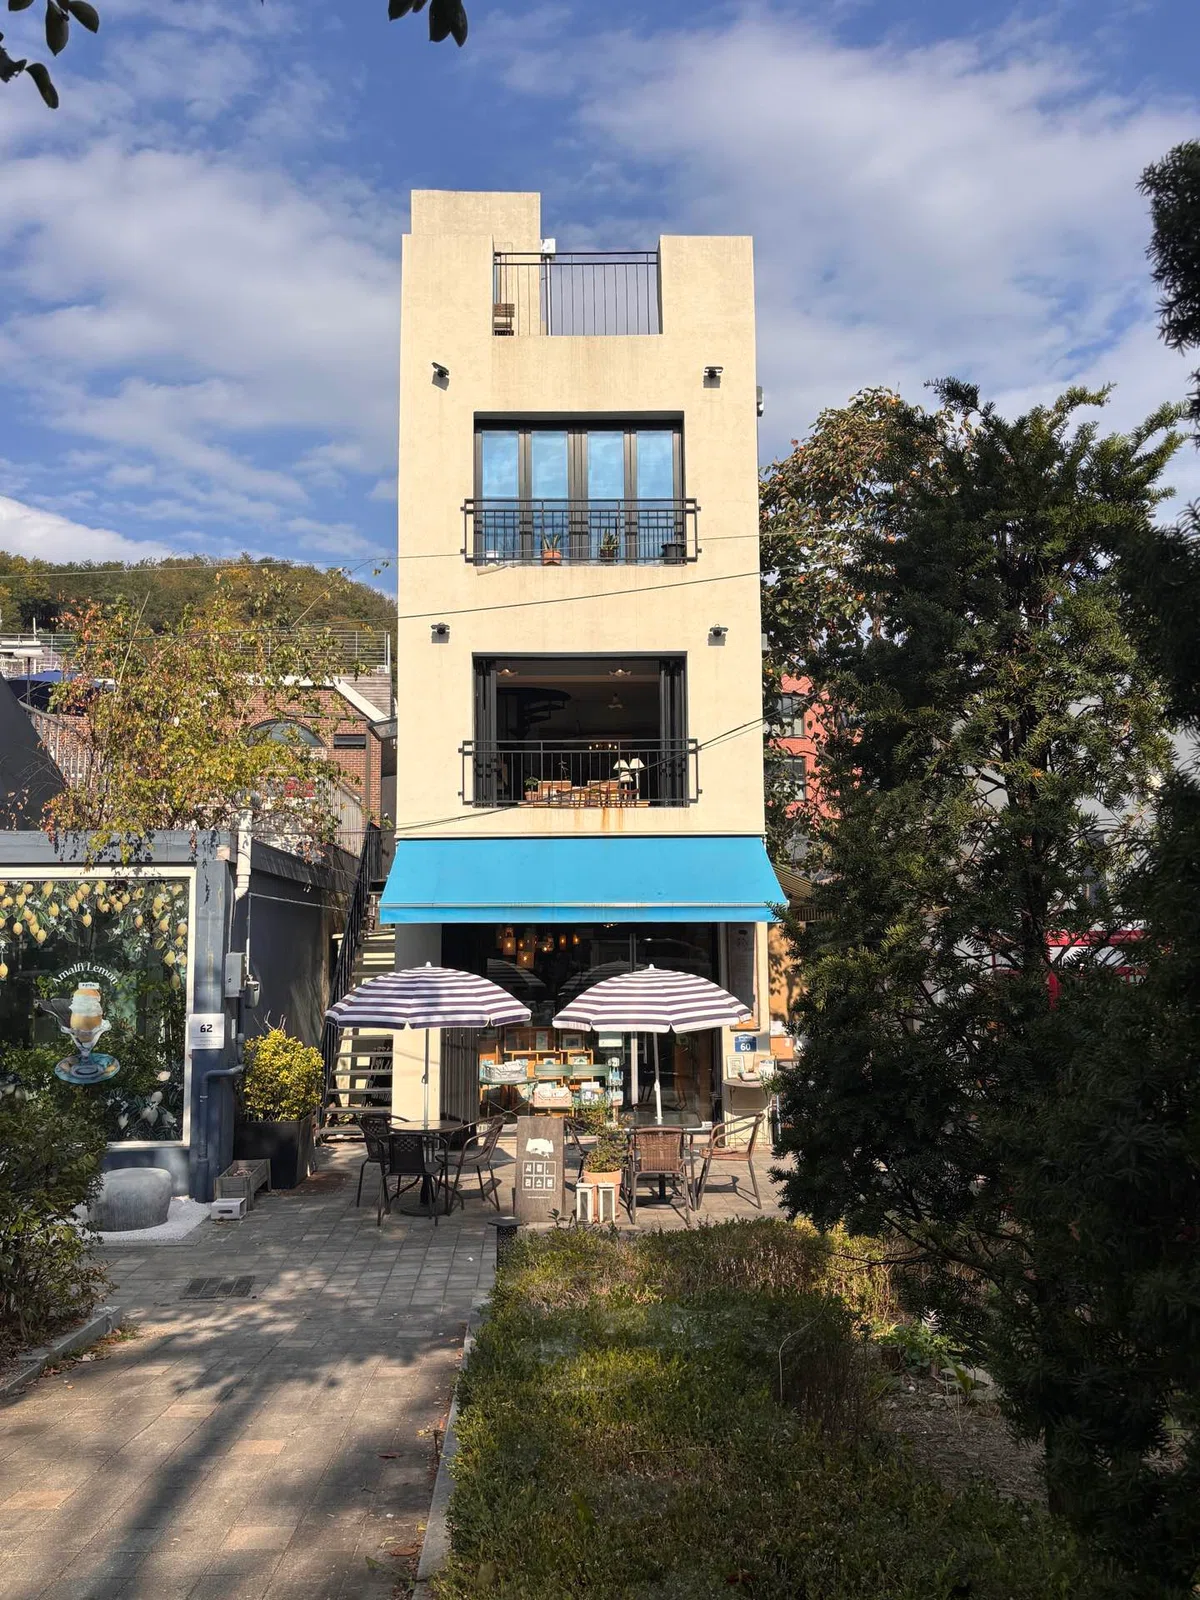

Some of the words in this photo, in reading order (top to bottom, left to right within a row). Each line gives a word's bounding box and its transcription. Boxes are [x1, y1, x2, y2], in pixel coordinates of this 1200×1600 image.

[52, 962, 84, 986] Amalfi
[86, 962, 118, 985] Lemon
[200, 1024, 213, 1033] 62
[740, 1042, 751, 1051] 60
